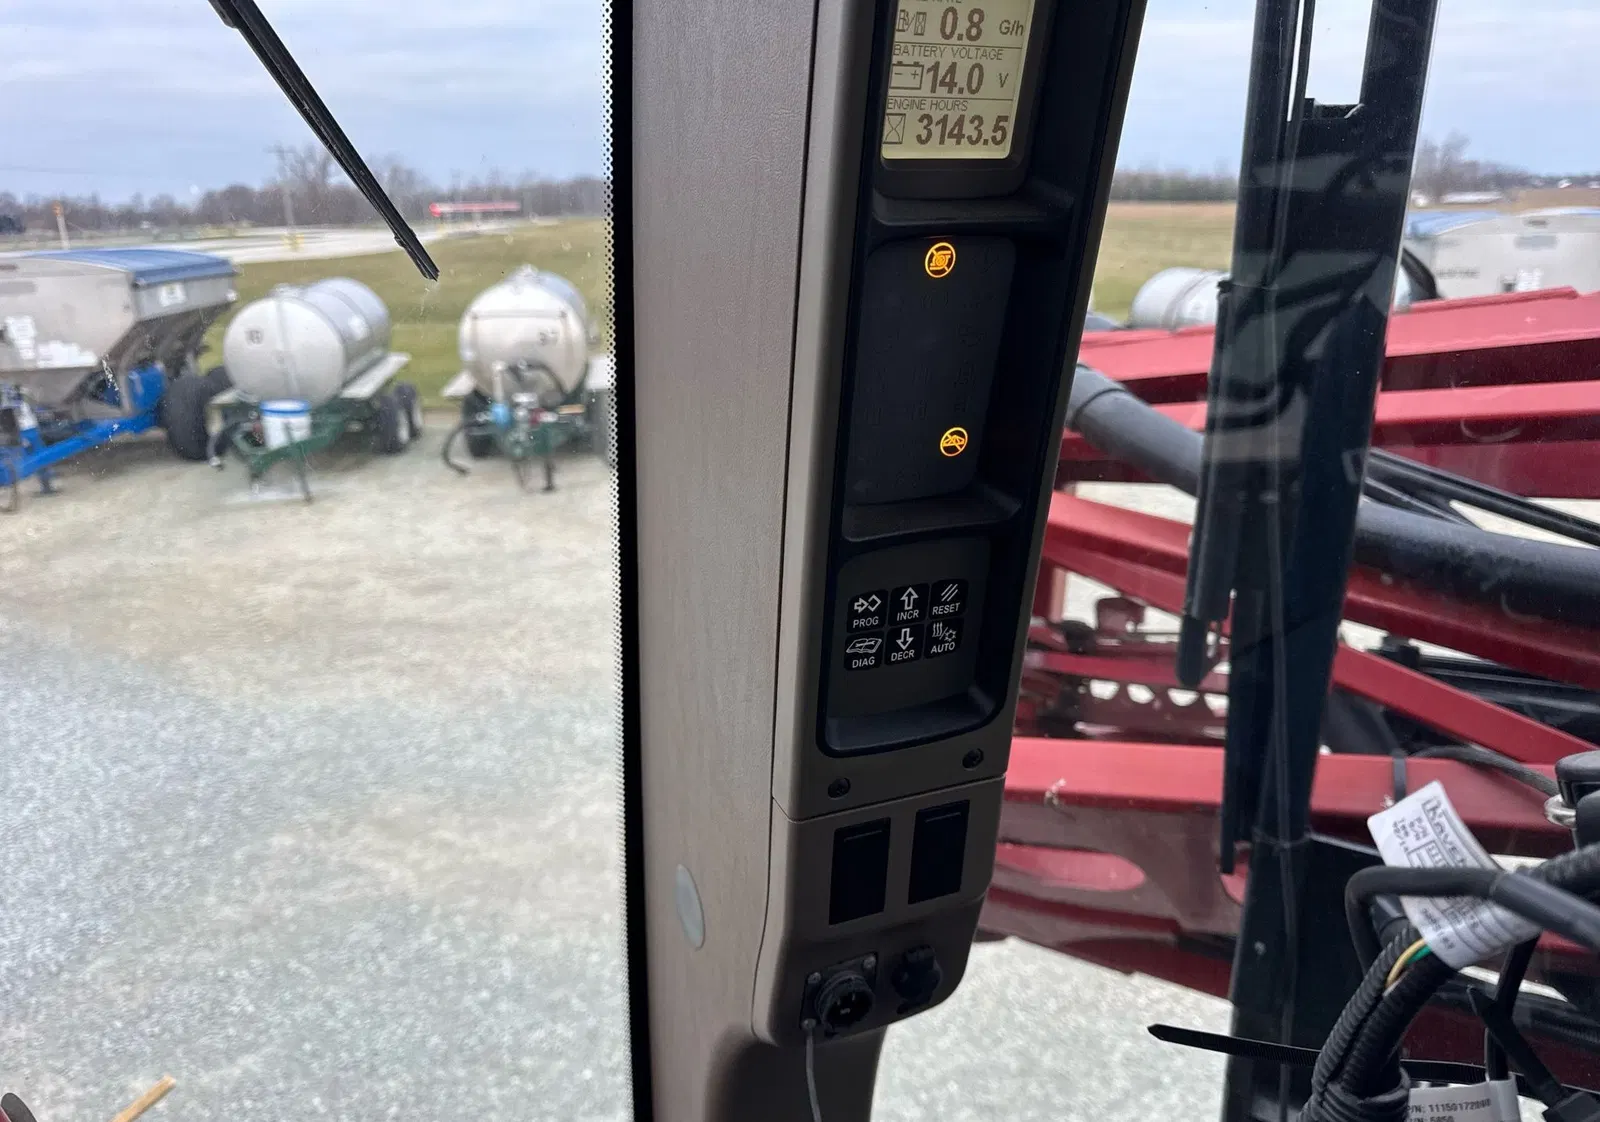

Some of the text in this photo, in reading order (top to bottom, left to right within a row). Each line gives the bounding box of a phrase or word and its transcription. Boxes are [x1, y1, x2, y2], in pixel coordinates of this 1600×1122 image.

[939, 6, 1024, 42] 0.8 G/h
[893, 44, 1004, 61] BATTERY VOLTAGE
[926, 60, 1009, 95] 14.0 V
[886, 99, 968, 112] ENGINE HOURS
[915, 113, 1009, 146] 3143.5
[896, 609, 919, 621] INCR
[932, 602, 960, 615] RESET
[852, 616, 878, 628] PROG
[930, 641, 955, 654] AUTO
[890, 649, 915, 661] DECR
[852, 656, 875, 668] DIAG
